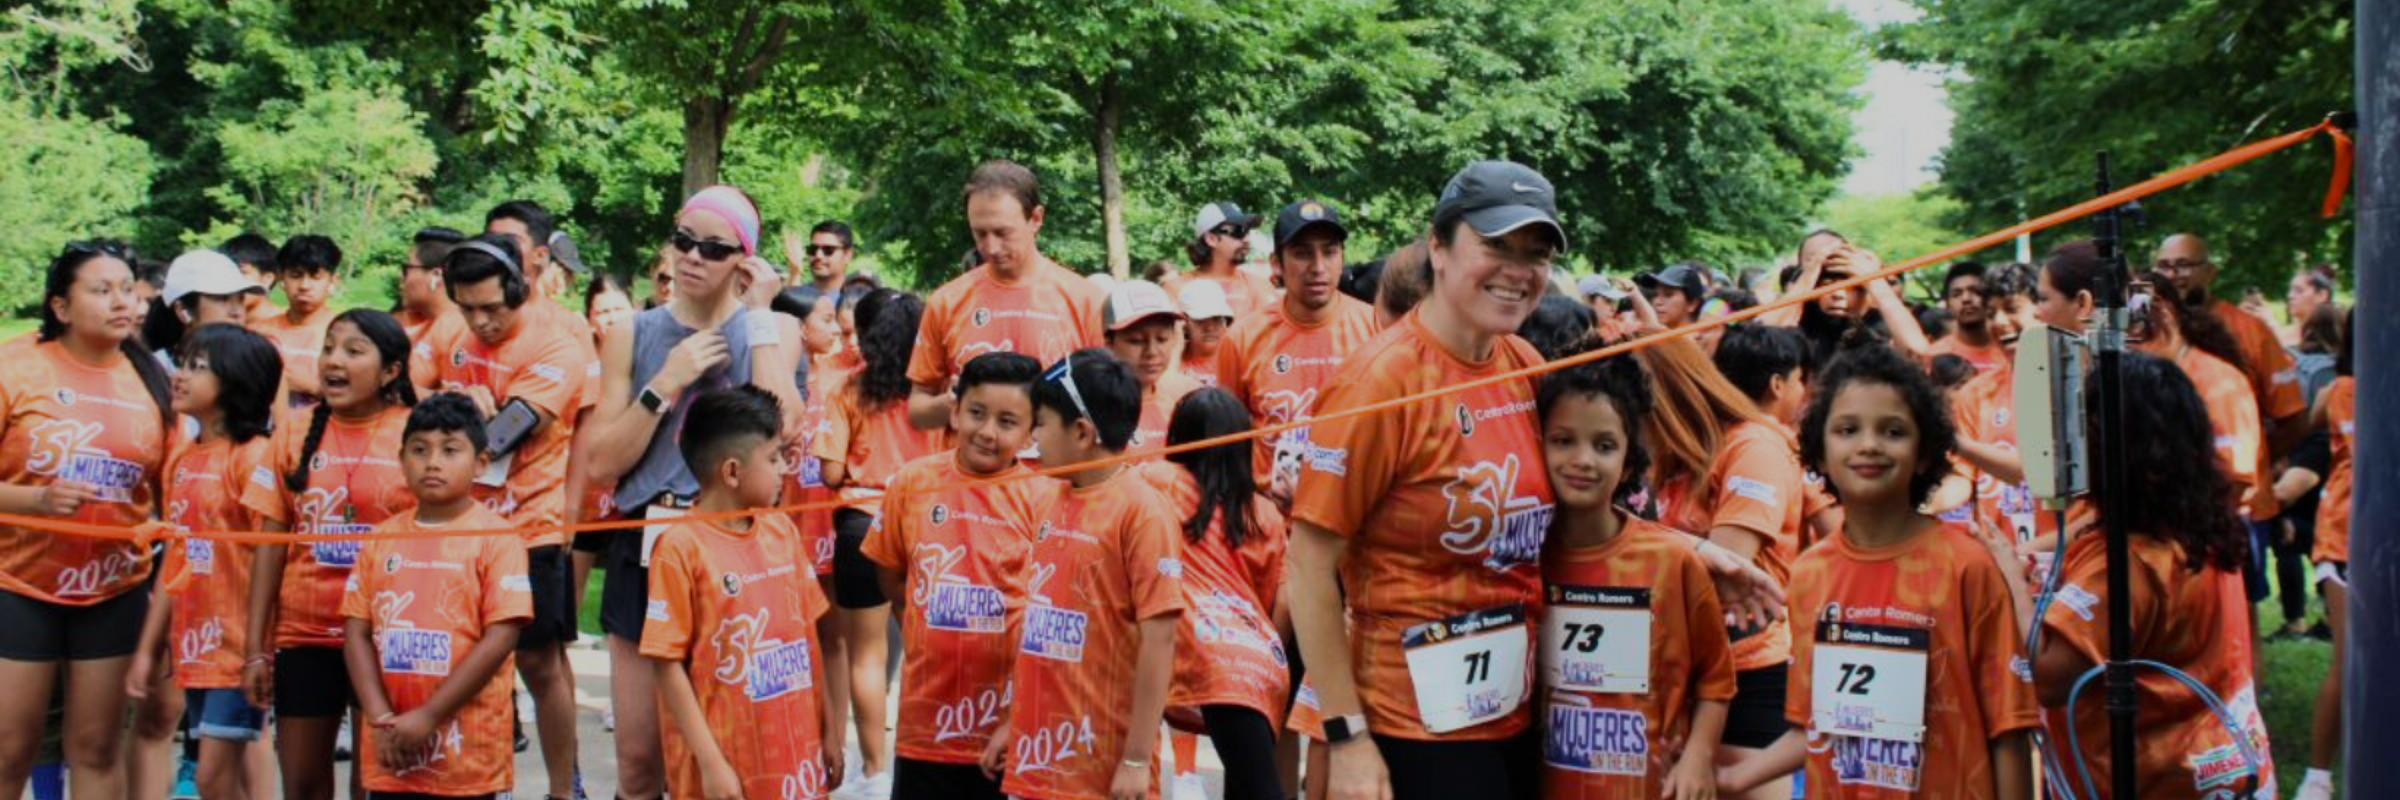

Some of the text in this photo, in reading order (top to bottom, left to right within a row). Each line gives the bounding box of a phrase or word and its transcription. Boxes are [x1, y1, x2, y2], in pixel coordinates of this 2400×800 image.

[937, 583, 1006, 618] MUJERES
[1565, 591, 1634, 604] Centro Romero
[385, 631, 449, 661] MUJERES
[1561, 622, 1605, 653] 73
[1843, 629, 1910, 645] Centro Romero
[758, 642, 810, 684] MUJERE
[1463, 649, 1491, 685] 71
[1836, 663, 1876, 695] 72
[1015, 715, 1096, 775] 2024
[1552, 706, 1646, 754] MUJERES
